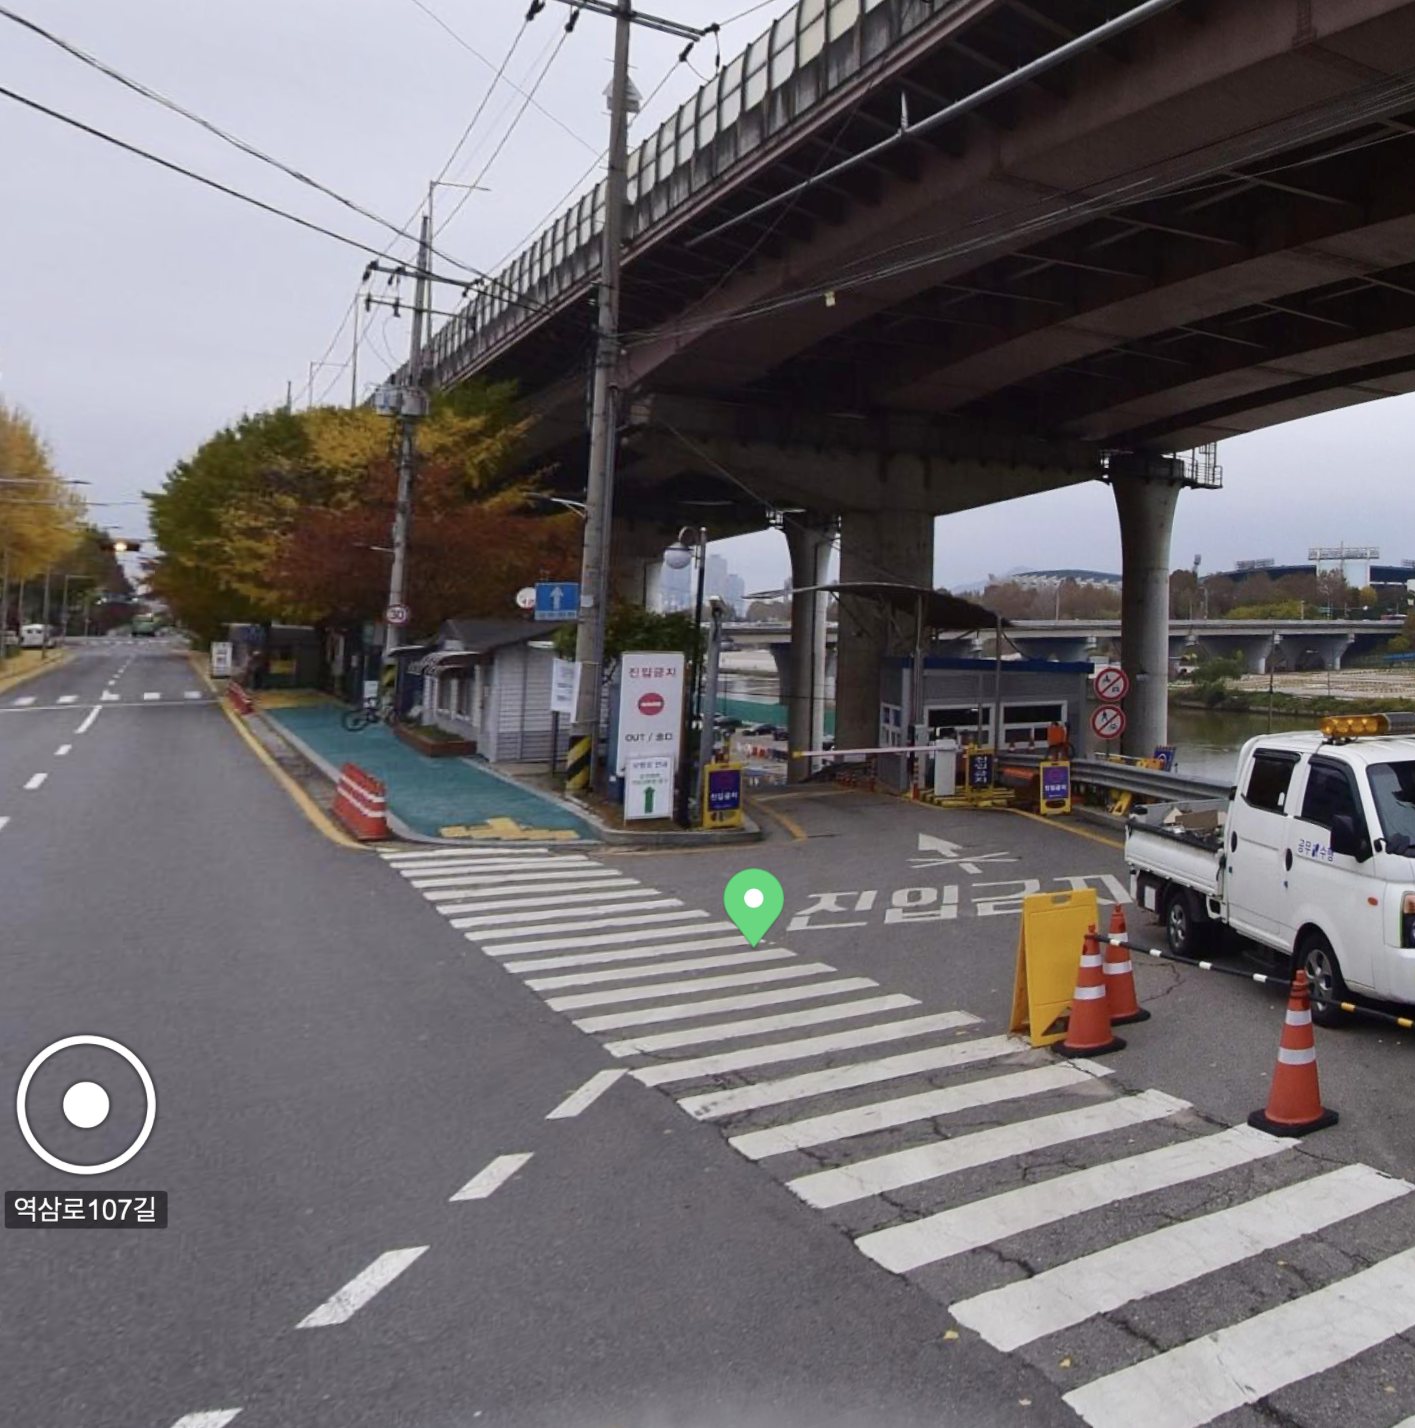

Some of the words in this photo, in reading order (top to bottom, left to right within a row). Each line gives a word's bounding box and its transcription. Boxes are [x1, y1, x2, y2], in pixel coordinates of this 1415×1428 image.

[629, 667, 676, 678] 진입금지
[625, 733, 645, 742] OUT
[786, 873, 1134, 932] 진입금지
